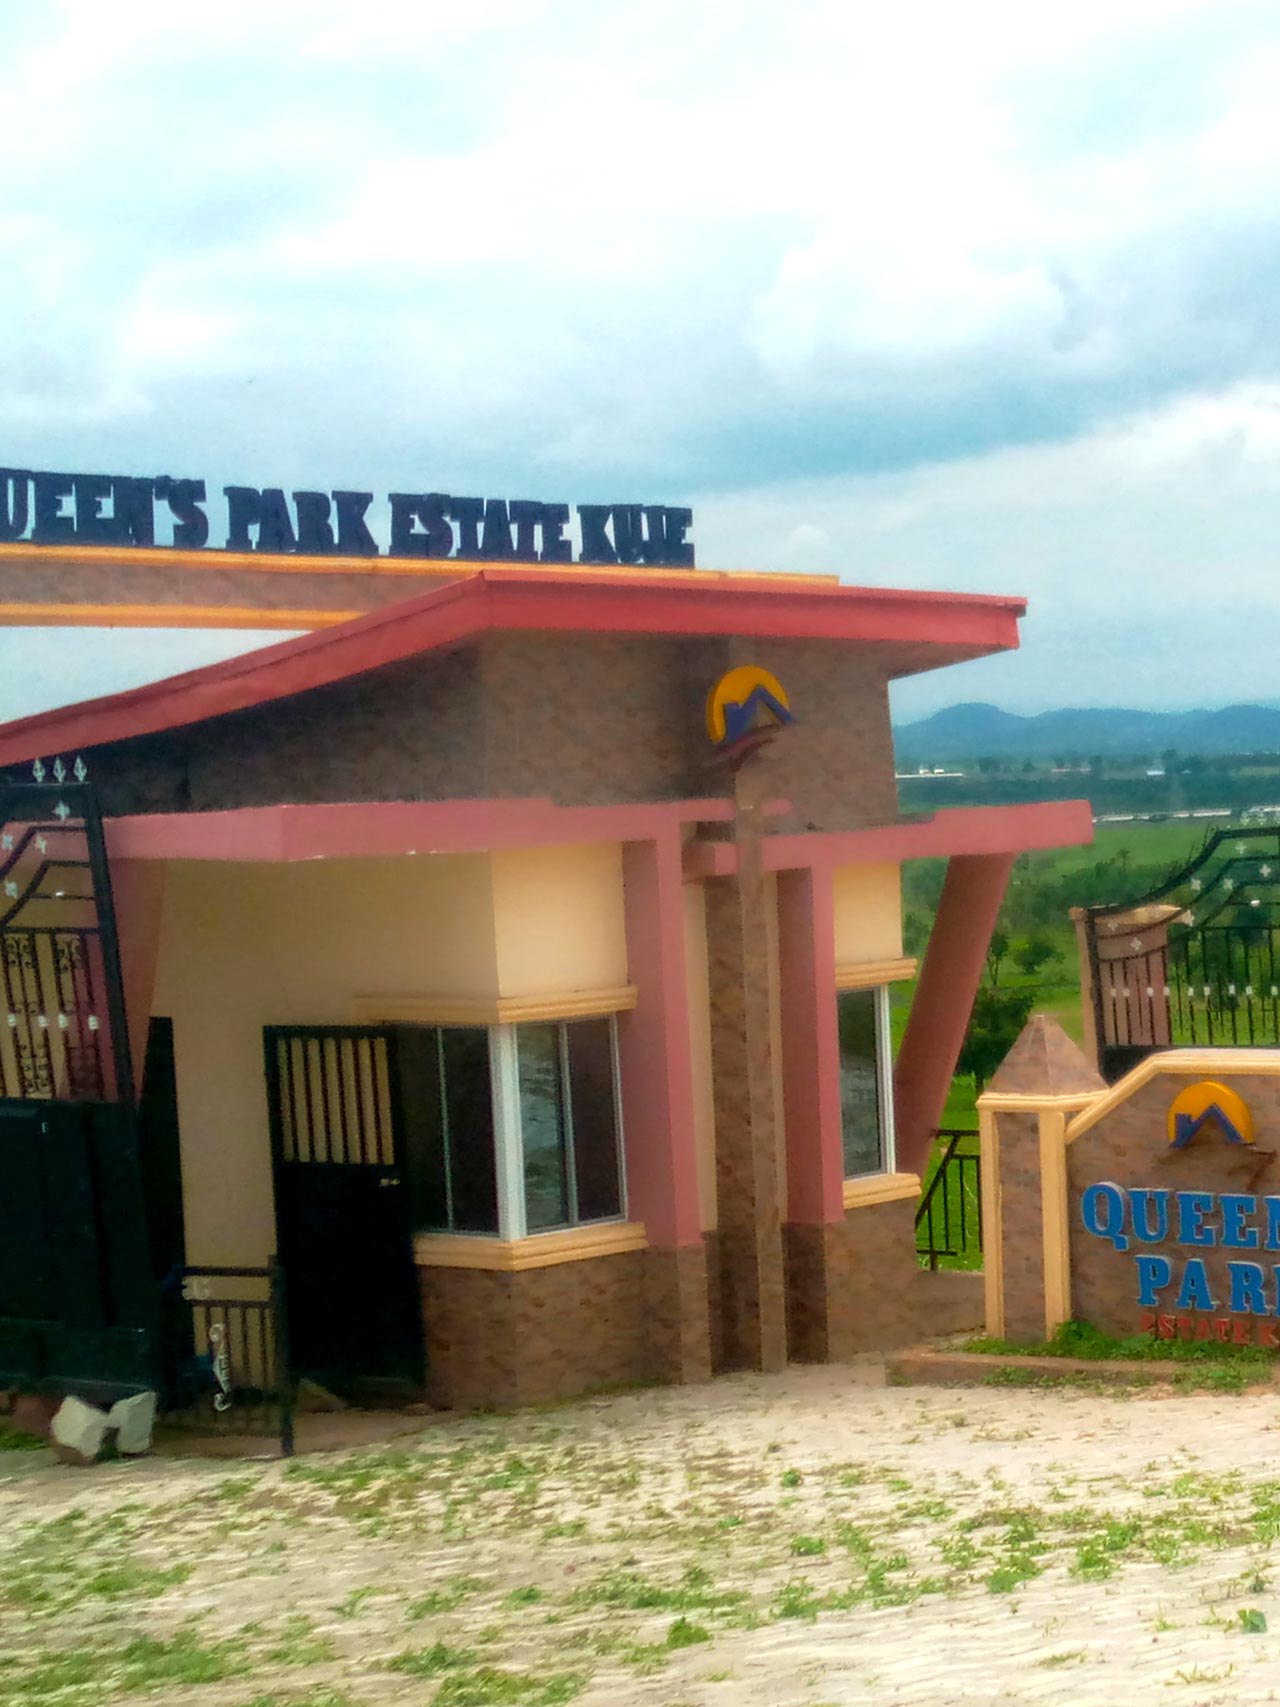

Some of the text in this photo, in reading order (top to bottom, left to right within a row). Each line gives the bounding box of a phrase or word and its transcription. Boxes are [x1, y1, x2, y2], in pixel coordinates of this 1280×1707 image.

[223, 486, 379, 556] PARK
[388, 493, 572, 563] ESTATE
[1139, 1312, 1251, 1346] ESTATE
